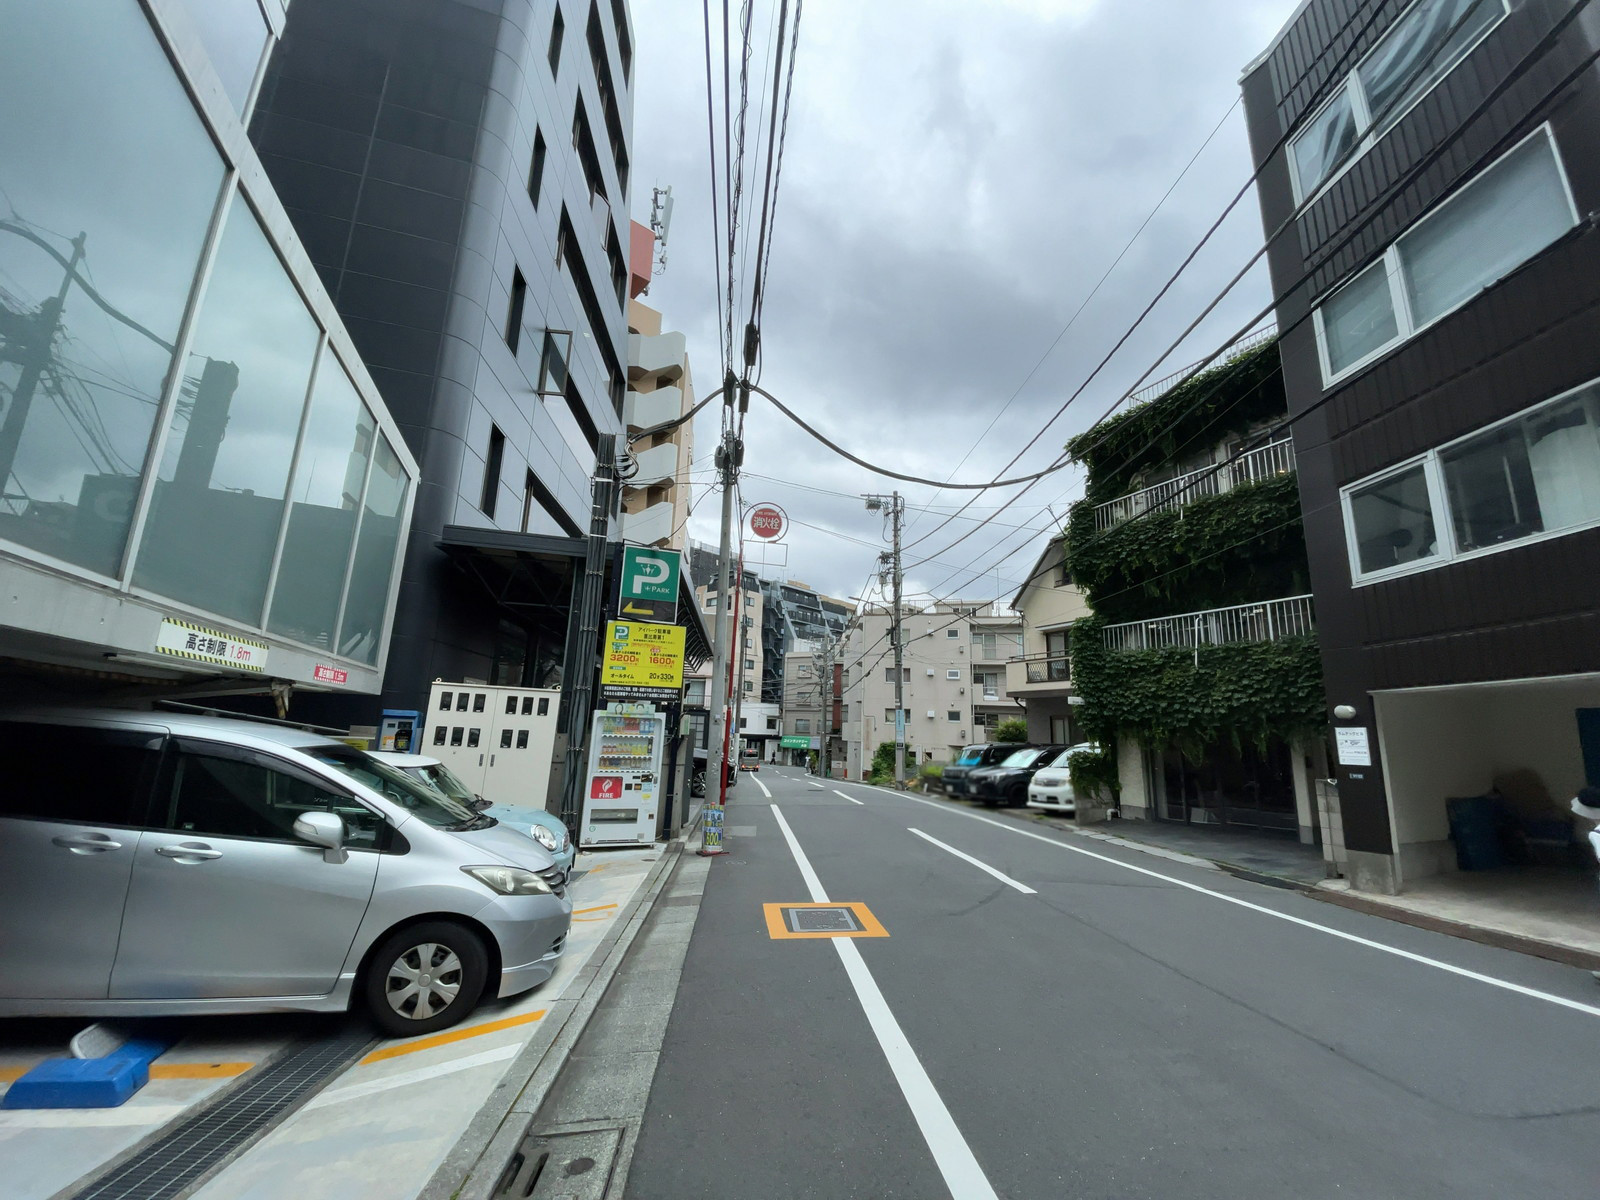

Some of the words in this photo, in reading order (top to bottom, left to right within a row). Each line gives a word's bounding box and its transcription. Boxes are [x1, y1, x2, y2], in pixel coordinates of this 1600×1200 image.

[753, 516, 779, 529] 消火栓
[632, 556, 670, 594] P
[185, 632, 228, 657] 高さ制限
[229, 644, 251, 661] 1.8m
